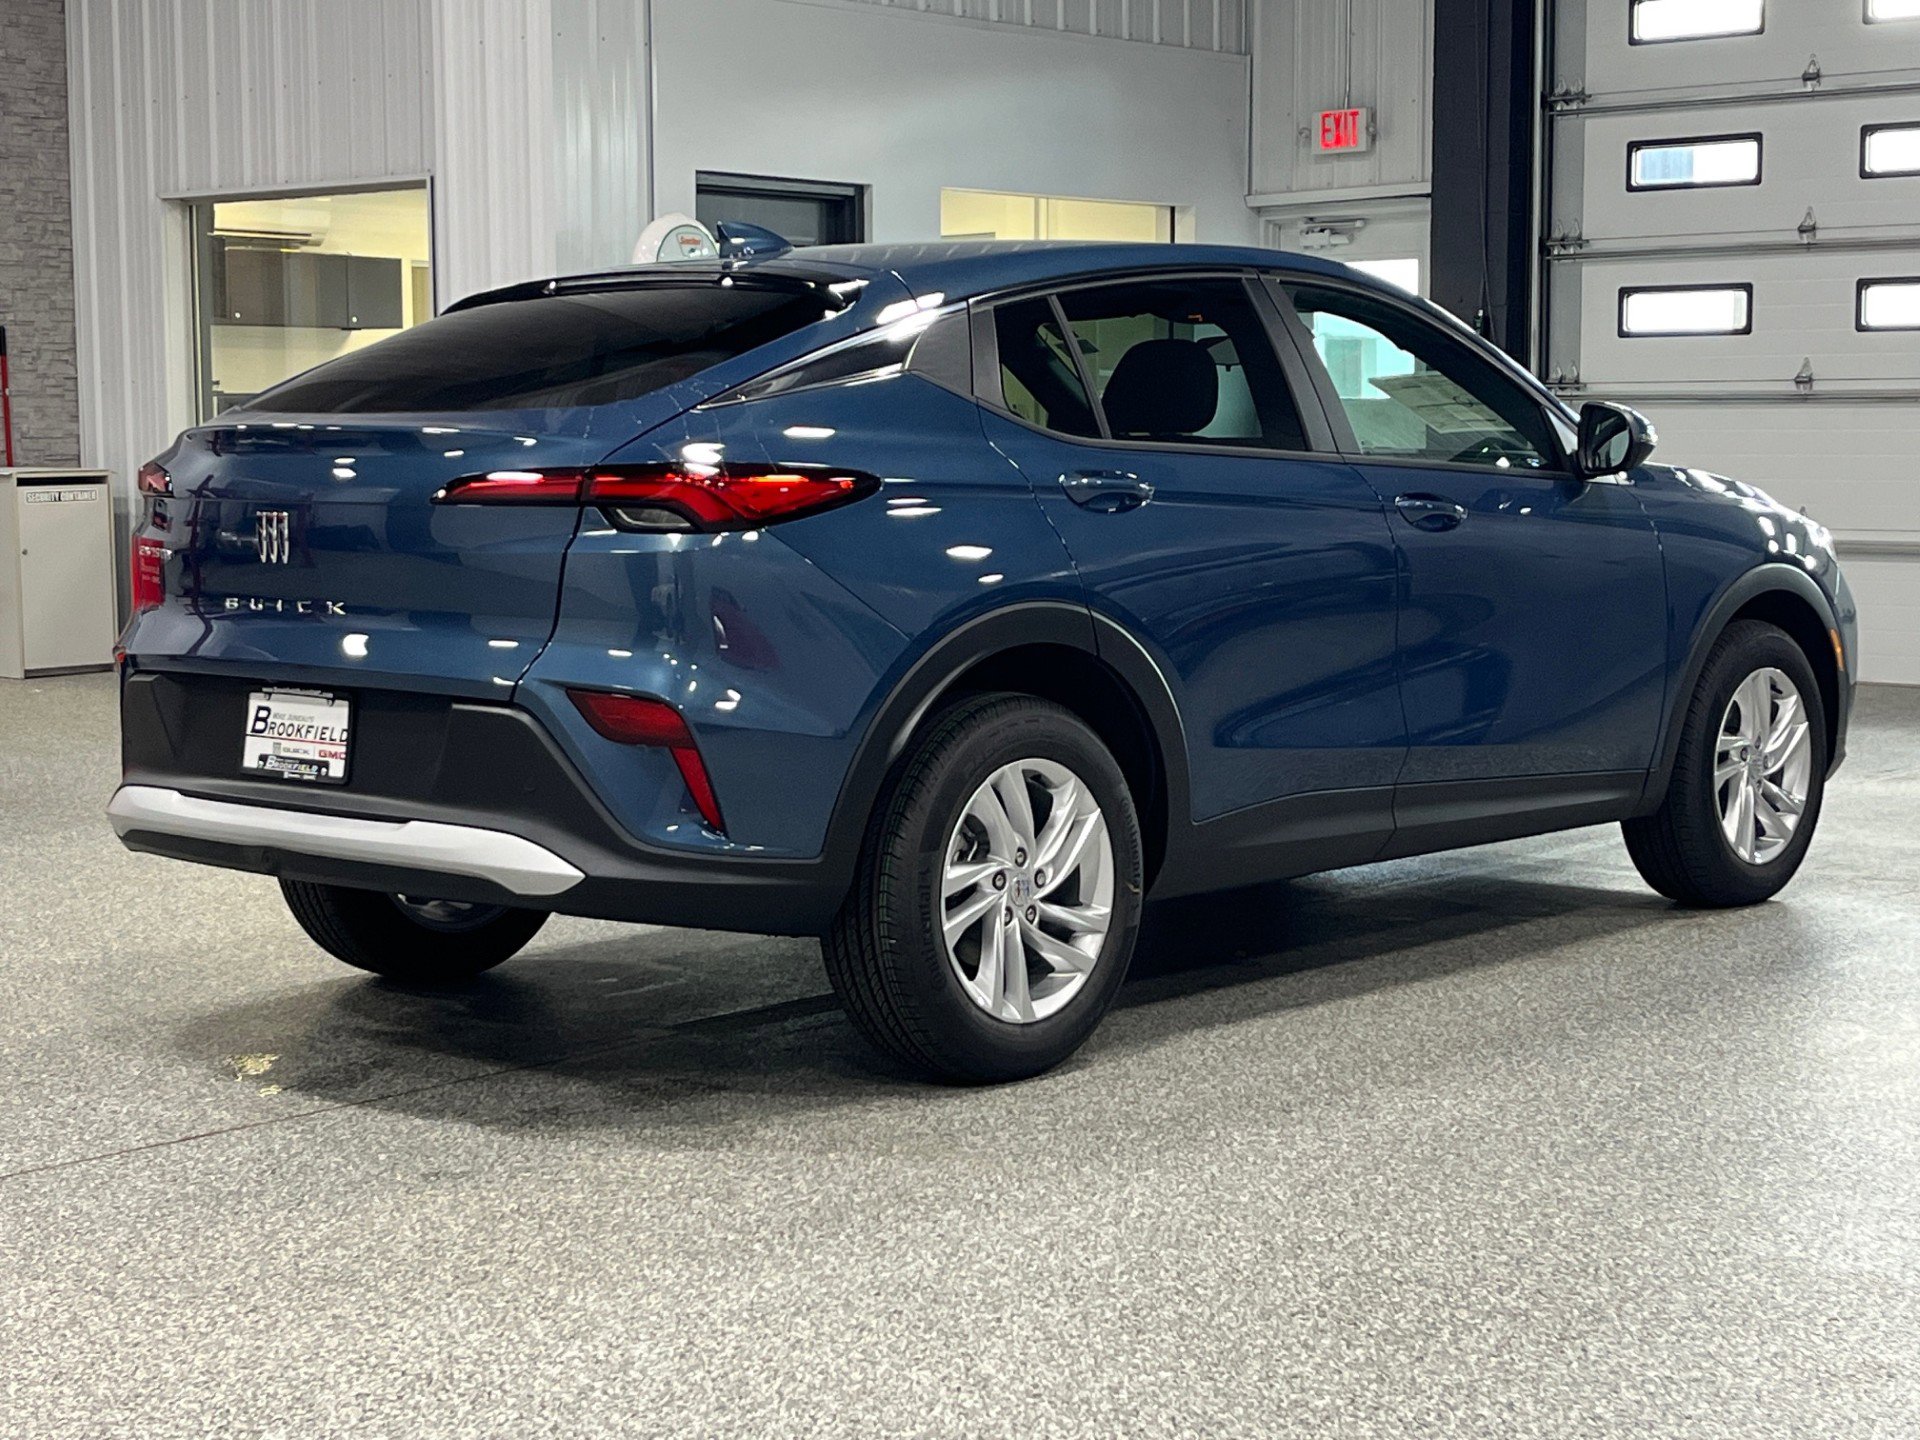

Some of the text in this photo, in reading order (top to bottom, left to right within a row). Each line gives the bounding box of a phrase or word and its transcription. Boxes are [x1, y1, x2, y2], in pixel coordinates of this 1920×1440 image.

[1321, 110, 1360, 149] EXIT
[225, 597, 346, 615] BUICK
[250, 705, 349, 743] BROOKFIELD
[318, 749, 347, 760] GMC
